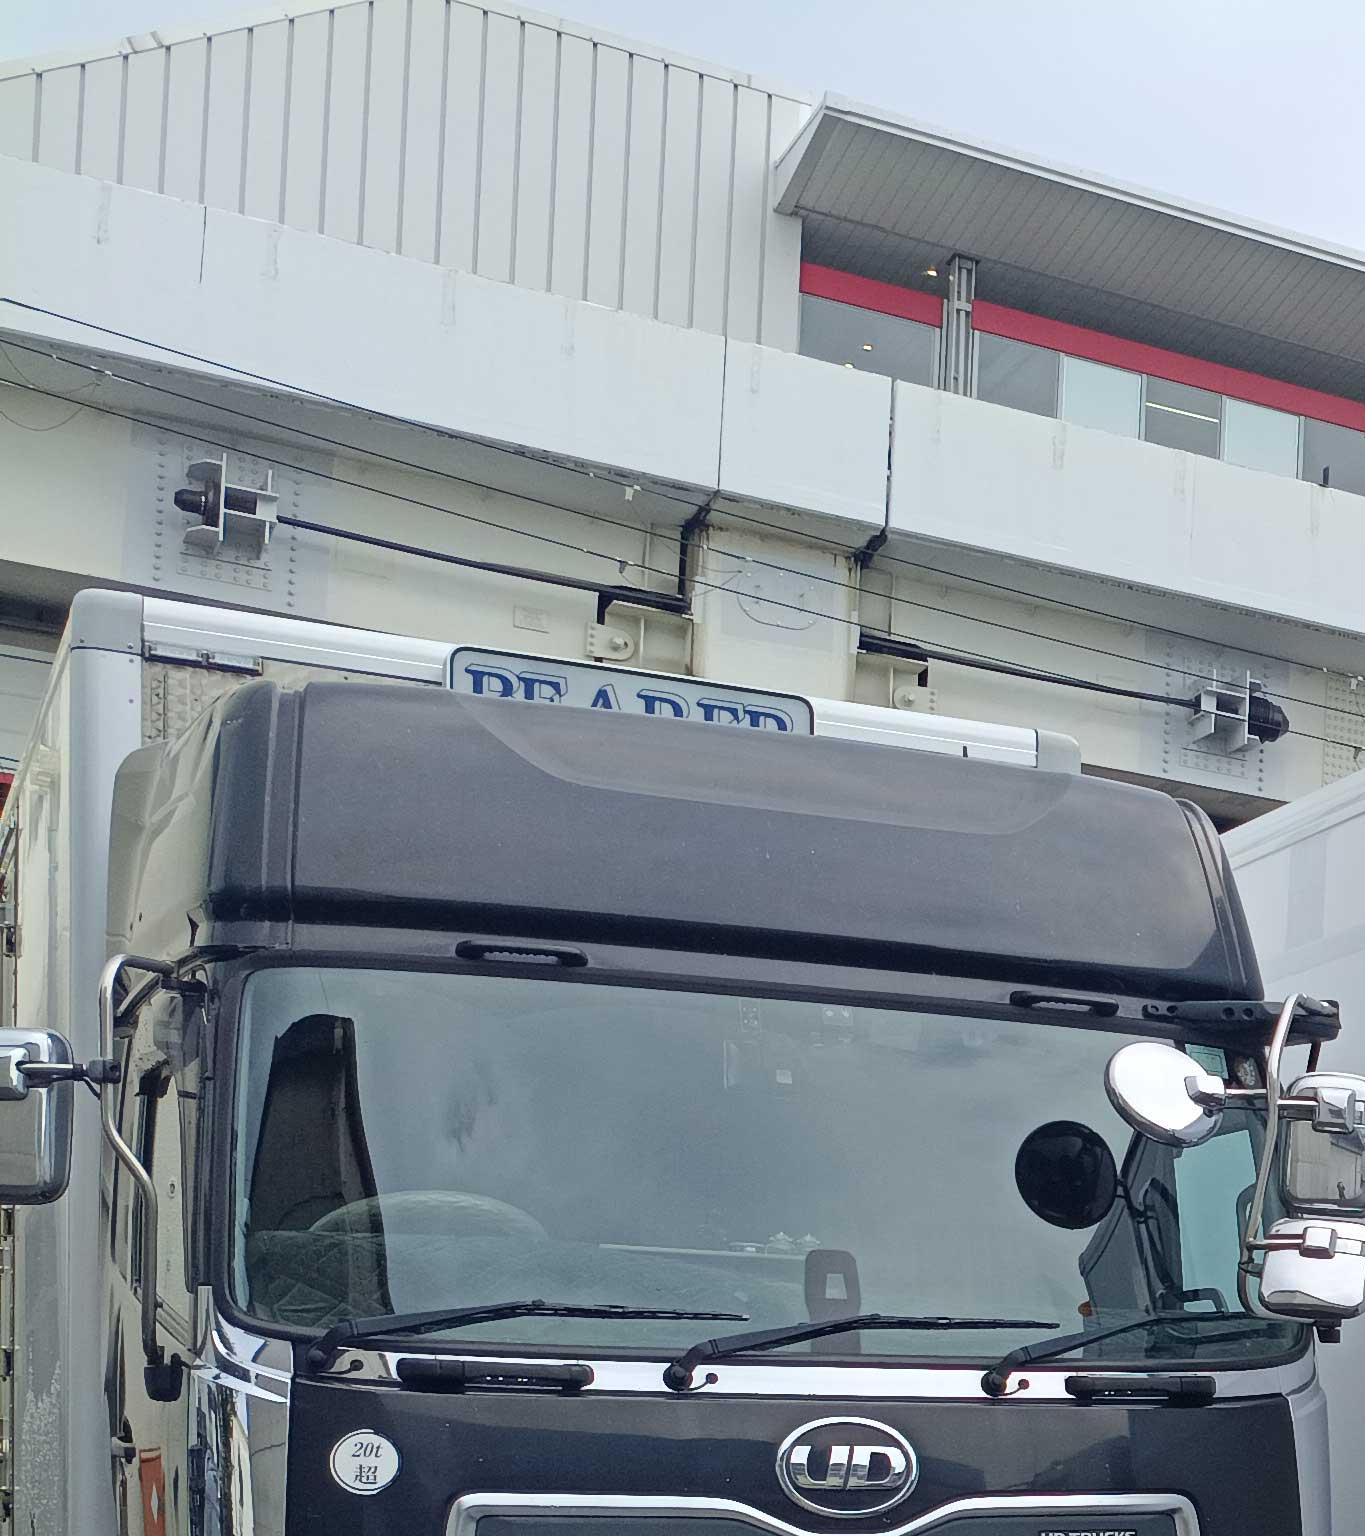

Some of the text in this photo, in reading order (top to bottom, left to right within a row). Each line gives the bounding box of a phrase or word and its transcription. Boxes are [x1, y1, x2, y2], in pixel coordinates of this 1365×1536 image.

[351, 1441, 383, 1458] 20t
[353, 1463, 379, 1485] 超
[790, 1445, 906, 1490] UD
